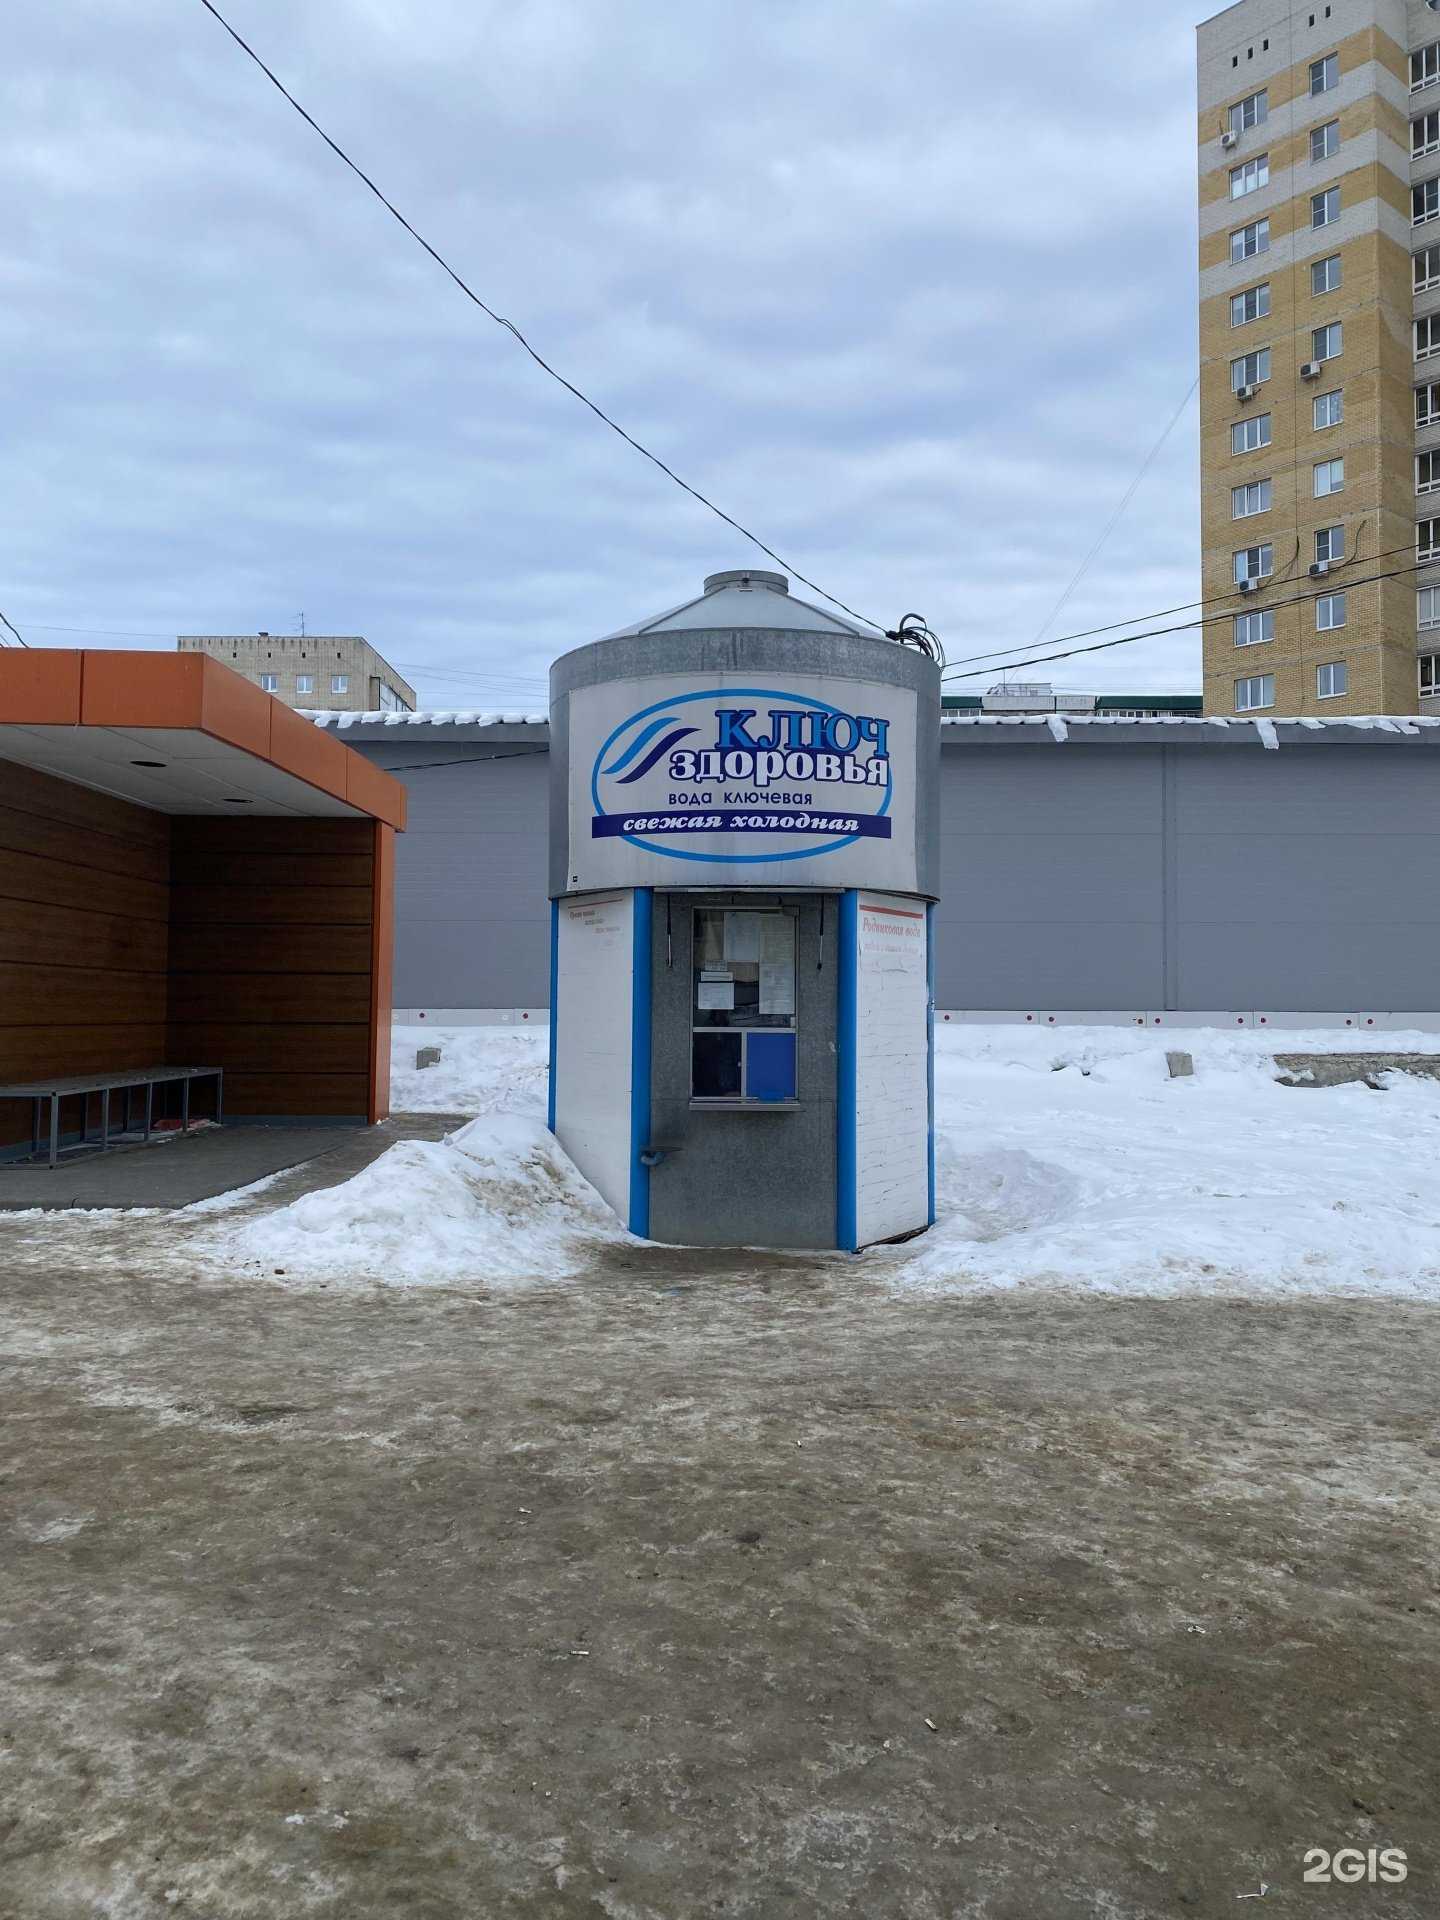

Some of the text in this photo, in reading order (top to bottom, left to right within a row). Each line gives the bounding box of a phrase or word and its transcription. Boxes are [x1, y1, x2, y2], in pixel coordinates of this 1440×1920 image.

[714, 709, 890, 758] КЛЮЧ
[669, 749, 889, 787] здоровья
[668, 791, 813, 806] вода ключевая
[622, 812, 860, 832] свежая холодная
